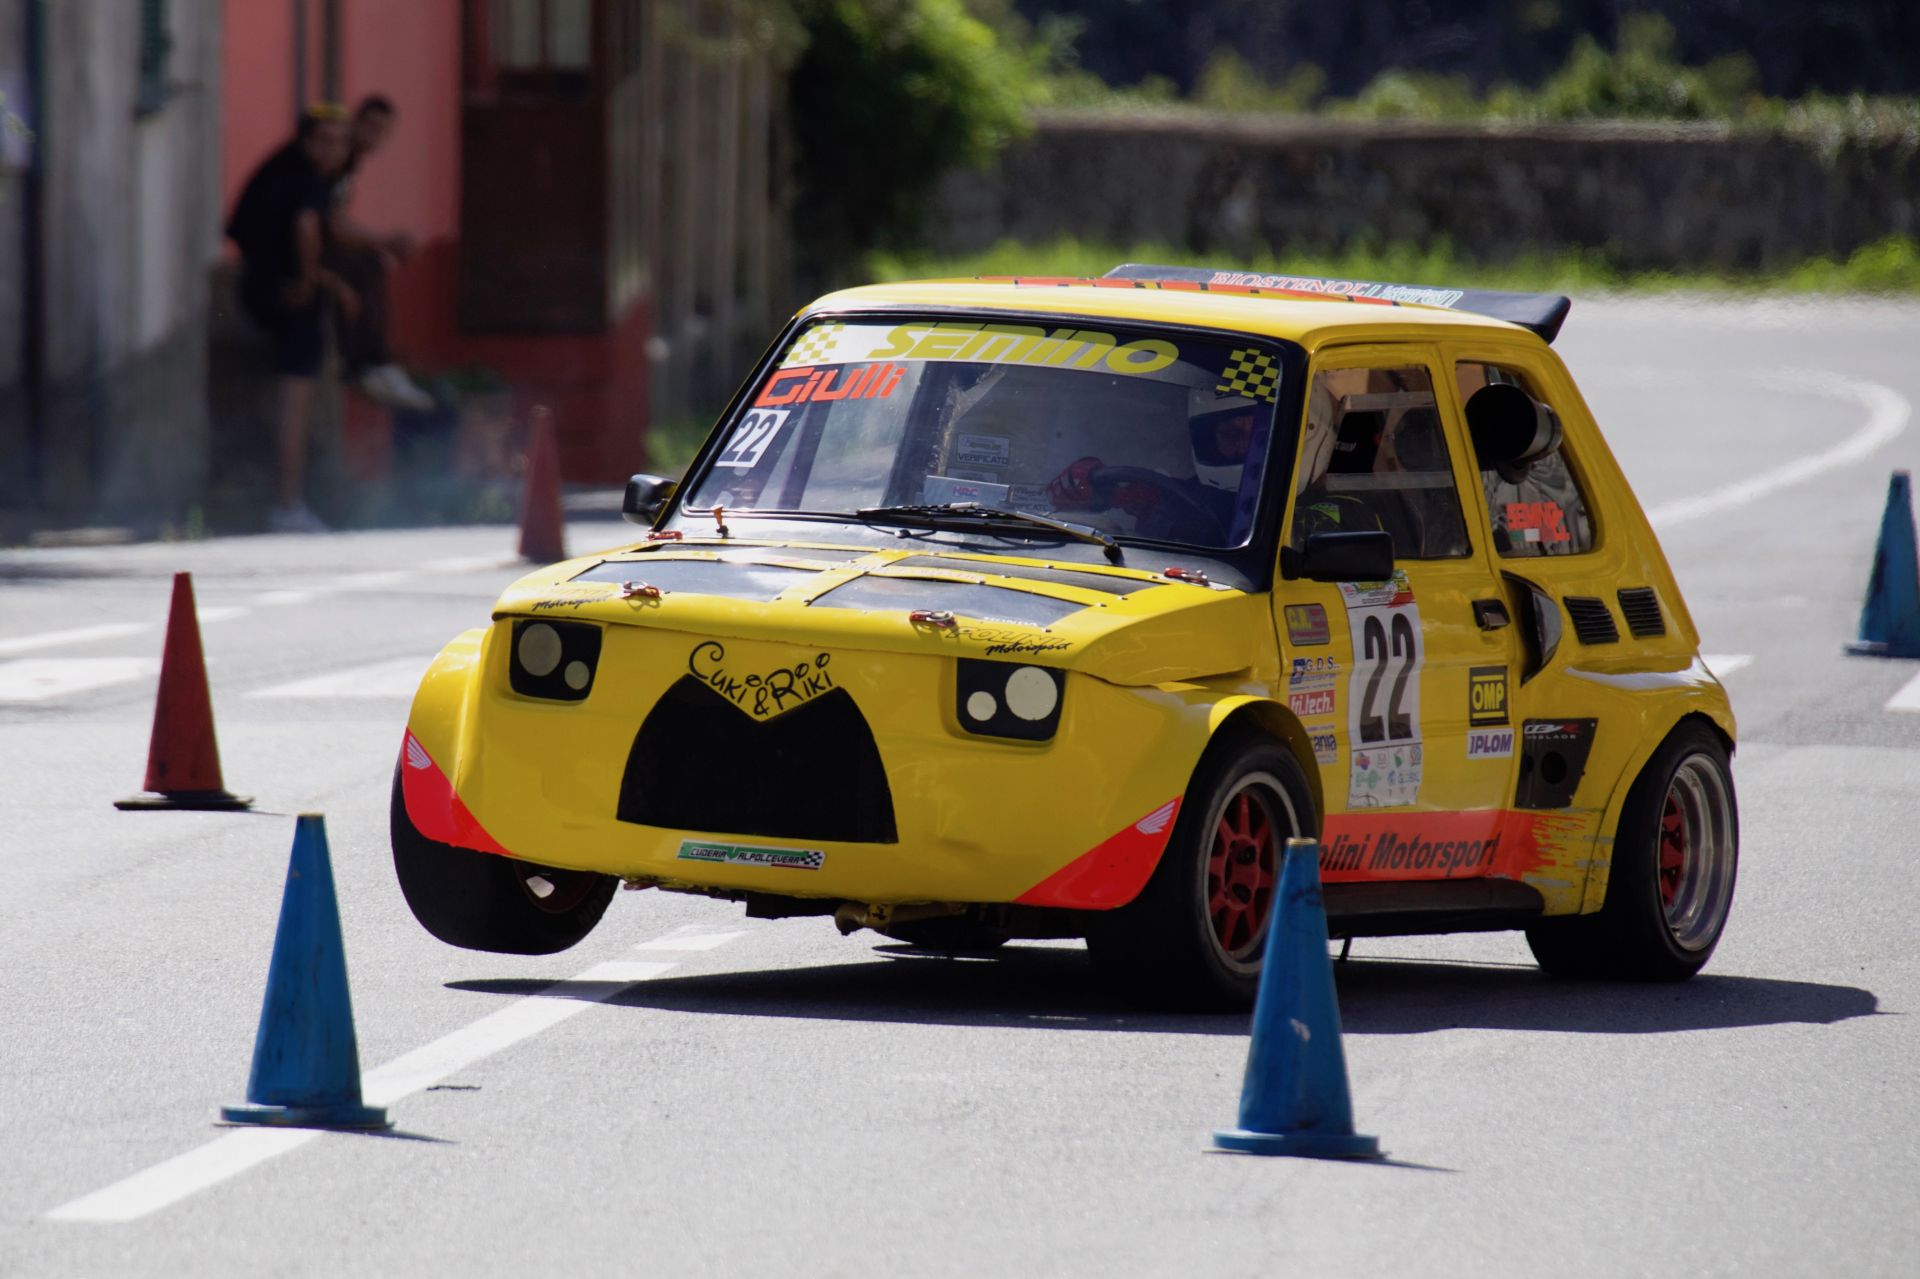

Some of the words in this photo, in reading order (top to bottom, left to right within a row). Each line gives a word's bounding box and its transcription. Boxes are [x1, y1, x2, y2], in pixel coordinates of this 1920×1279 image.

[720, 412, 778, 462] 22
[958, 453, 1009, 465] VERIFICATO
[985, 642, 1073, 656] Motorsport
[1360, 613, 1416, 743] 22
[1472, 682, 1504, 710] OMP
[1469, 733, 1512, 754] IPLOM
[1320, 834, 1371, 871] olini
[1368, 832, 1501, 877] Motorsport
